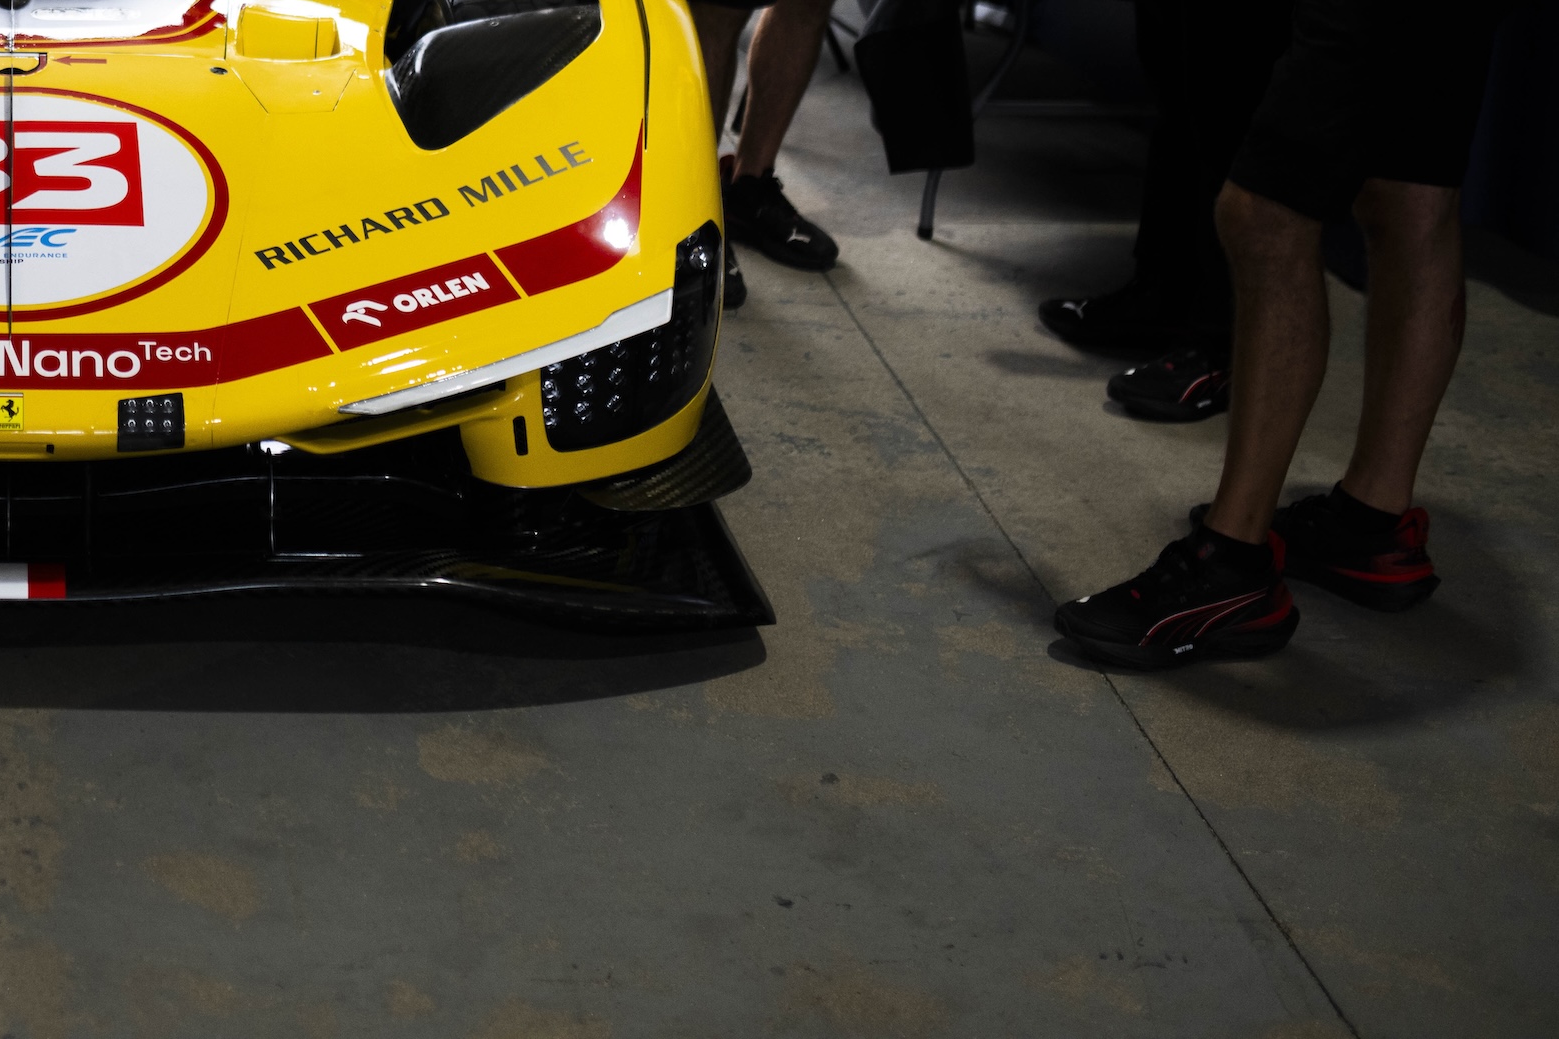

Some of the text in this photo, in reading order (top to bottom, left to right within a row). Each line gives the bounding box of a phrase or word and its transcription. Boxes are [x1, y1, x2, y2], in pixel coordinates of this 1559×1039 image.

[253, 140, 594, 271] RICHARD MILLE
[392, 271, 491, 313] ORLEN
